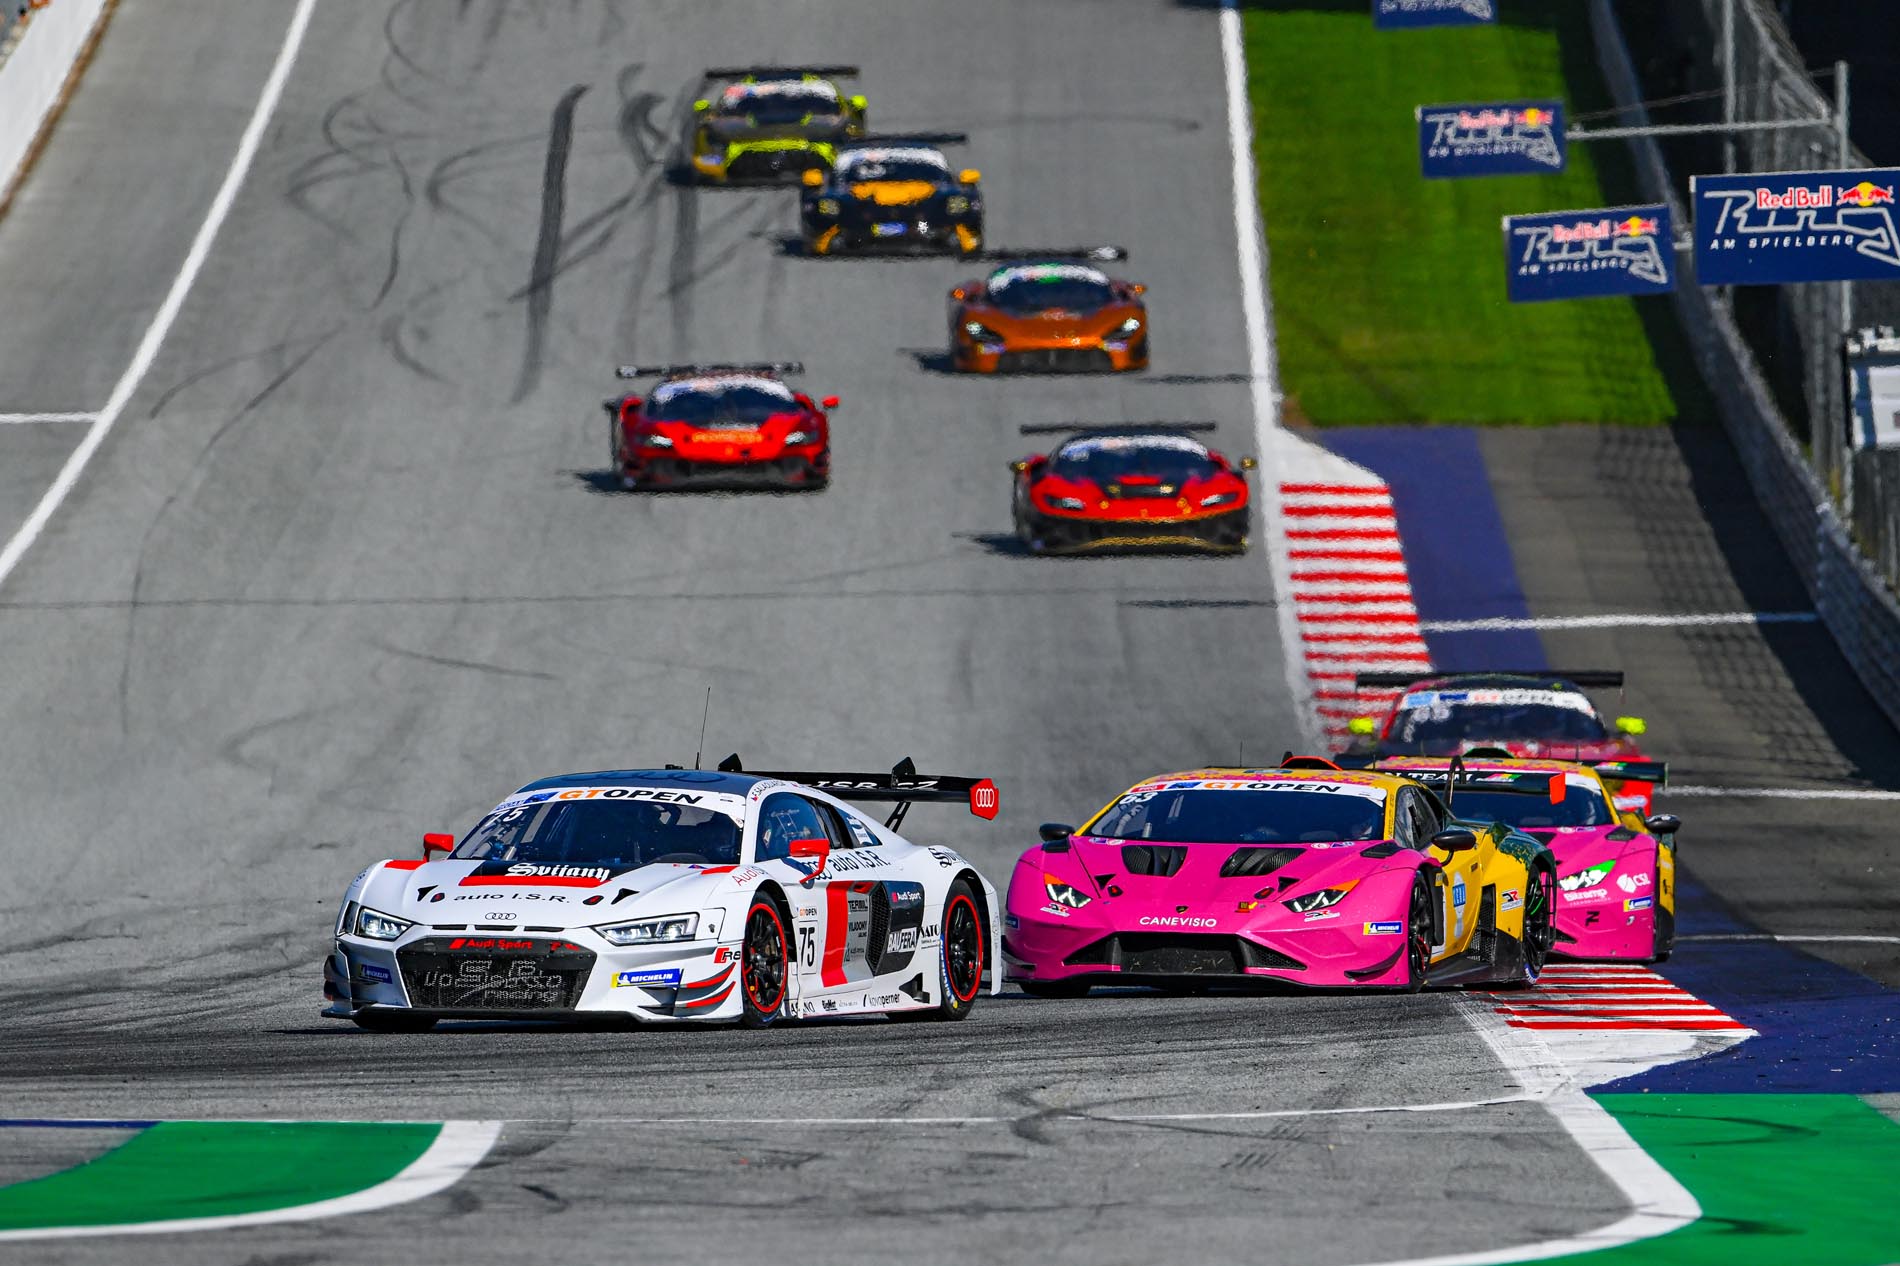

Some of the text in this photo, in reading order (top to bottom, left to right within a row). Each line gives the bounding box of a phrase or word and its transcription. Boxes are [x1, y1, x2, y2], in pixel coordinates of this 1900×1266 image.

[1757, 185, 1833, 210] Red Bull
[1710, 234, 1854, 251] AM SPIELBERG
[1119, 791, 1158, 804] 63
[485, 805, 530, 827] 75
[828, 854, 858, 872] auto
[454, 893, 504, 901] auto
[1139, 916, 1218, 928] CANEVISIO
[467, 938, 533, 950] Audi Sport
[799, 926, 816, 967] 75
[722, 950, 741, 961] R8
[630, 973, 673, 983] MICHELIN
